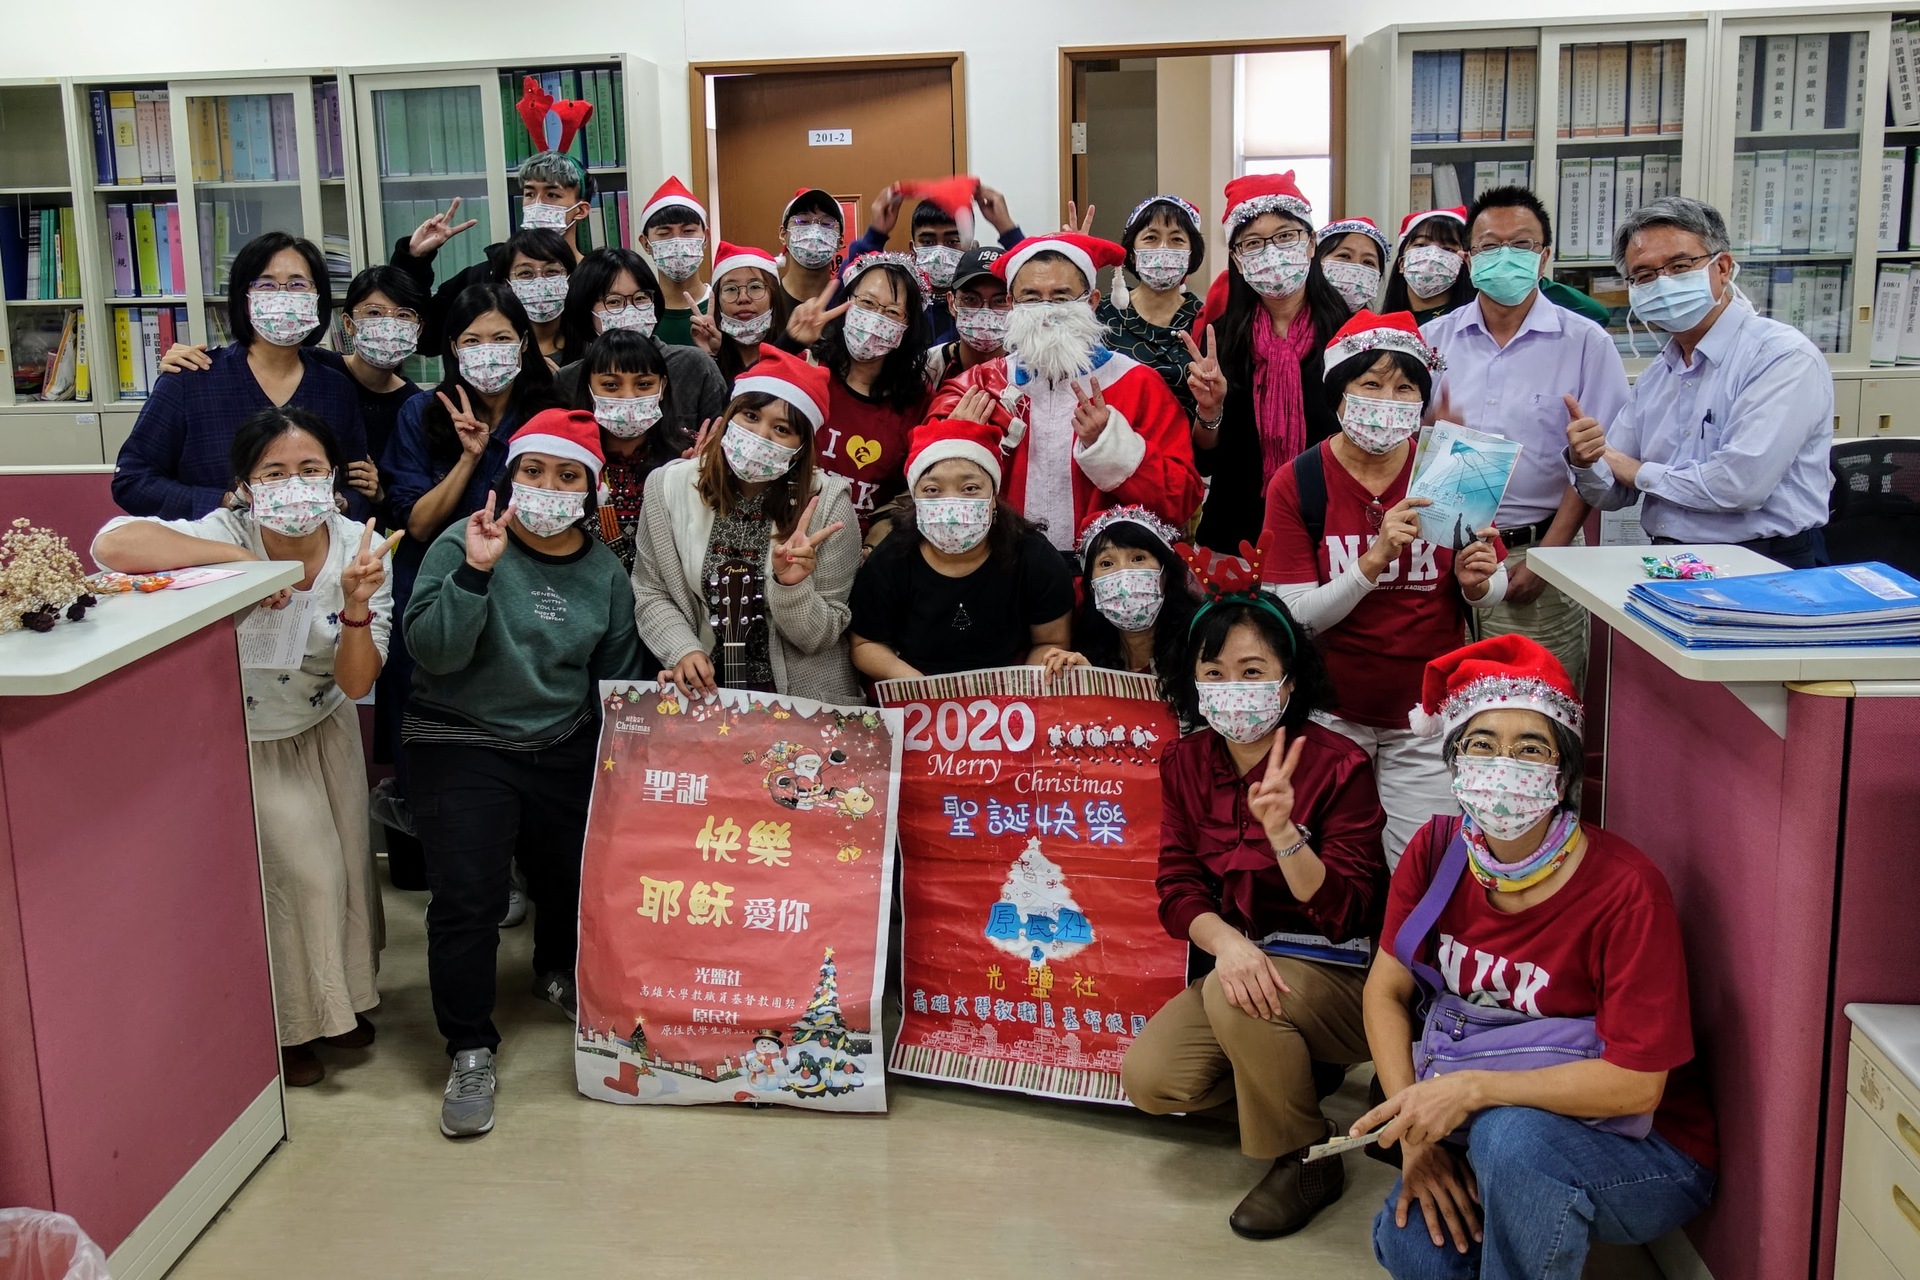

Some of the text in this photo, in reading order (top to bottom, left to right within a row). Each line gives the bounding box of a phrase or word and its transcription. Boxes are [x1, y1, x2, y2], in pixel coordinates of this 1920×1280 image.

[1773, 52, 1786, 119] 教師鐘點費
[1804, 50, 1818, 118] 教師鐘點費
[815, 132, 845, 143] 201-2
[115, 231, 128, 268] 法規
[978, 250, 1003, 261] 198
[822, 427, 842, 459] I
[725, 565, 748, 575] Fender
[616, 721, 651, 732] Christmas
[625, 715, 644, 723] MERRY
[904, 699, 1036, 752] 2020
[928, 753, 1002, 784] Merry
[1014, 769, 1124, 796] Christmas
[642, 768, 709, 806] 聖誕
[942, 794, 1128, 846] 聖誕快樂
[695, 815, 792, 867] 快樂
[637, 875, 810, 933] 耶穌 愛你
[987, 903, 1088, 940] 原民社
[694, 966, 742, 987] 光鹽社
[986, 963, 1100, 999] 光鹽社
[692, 1007, 740, 1026] 原民社
